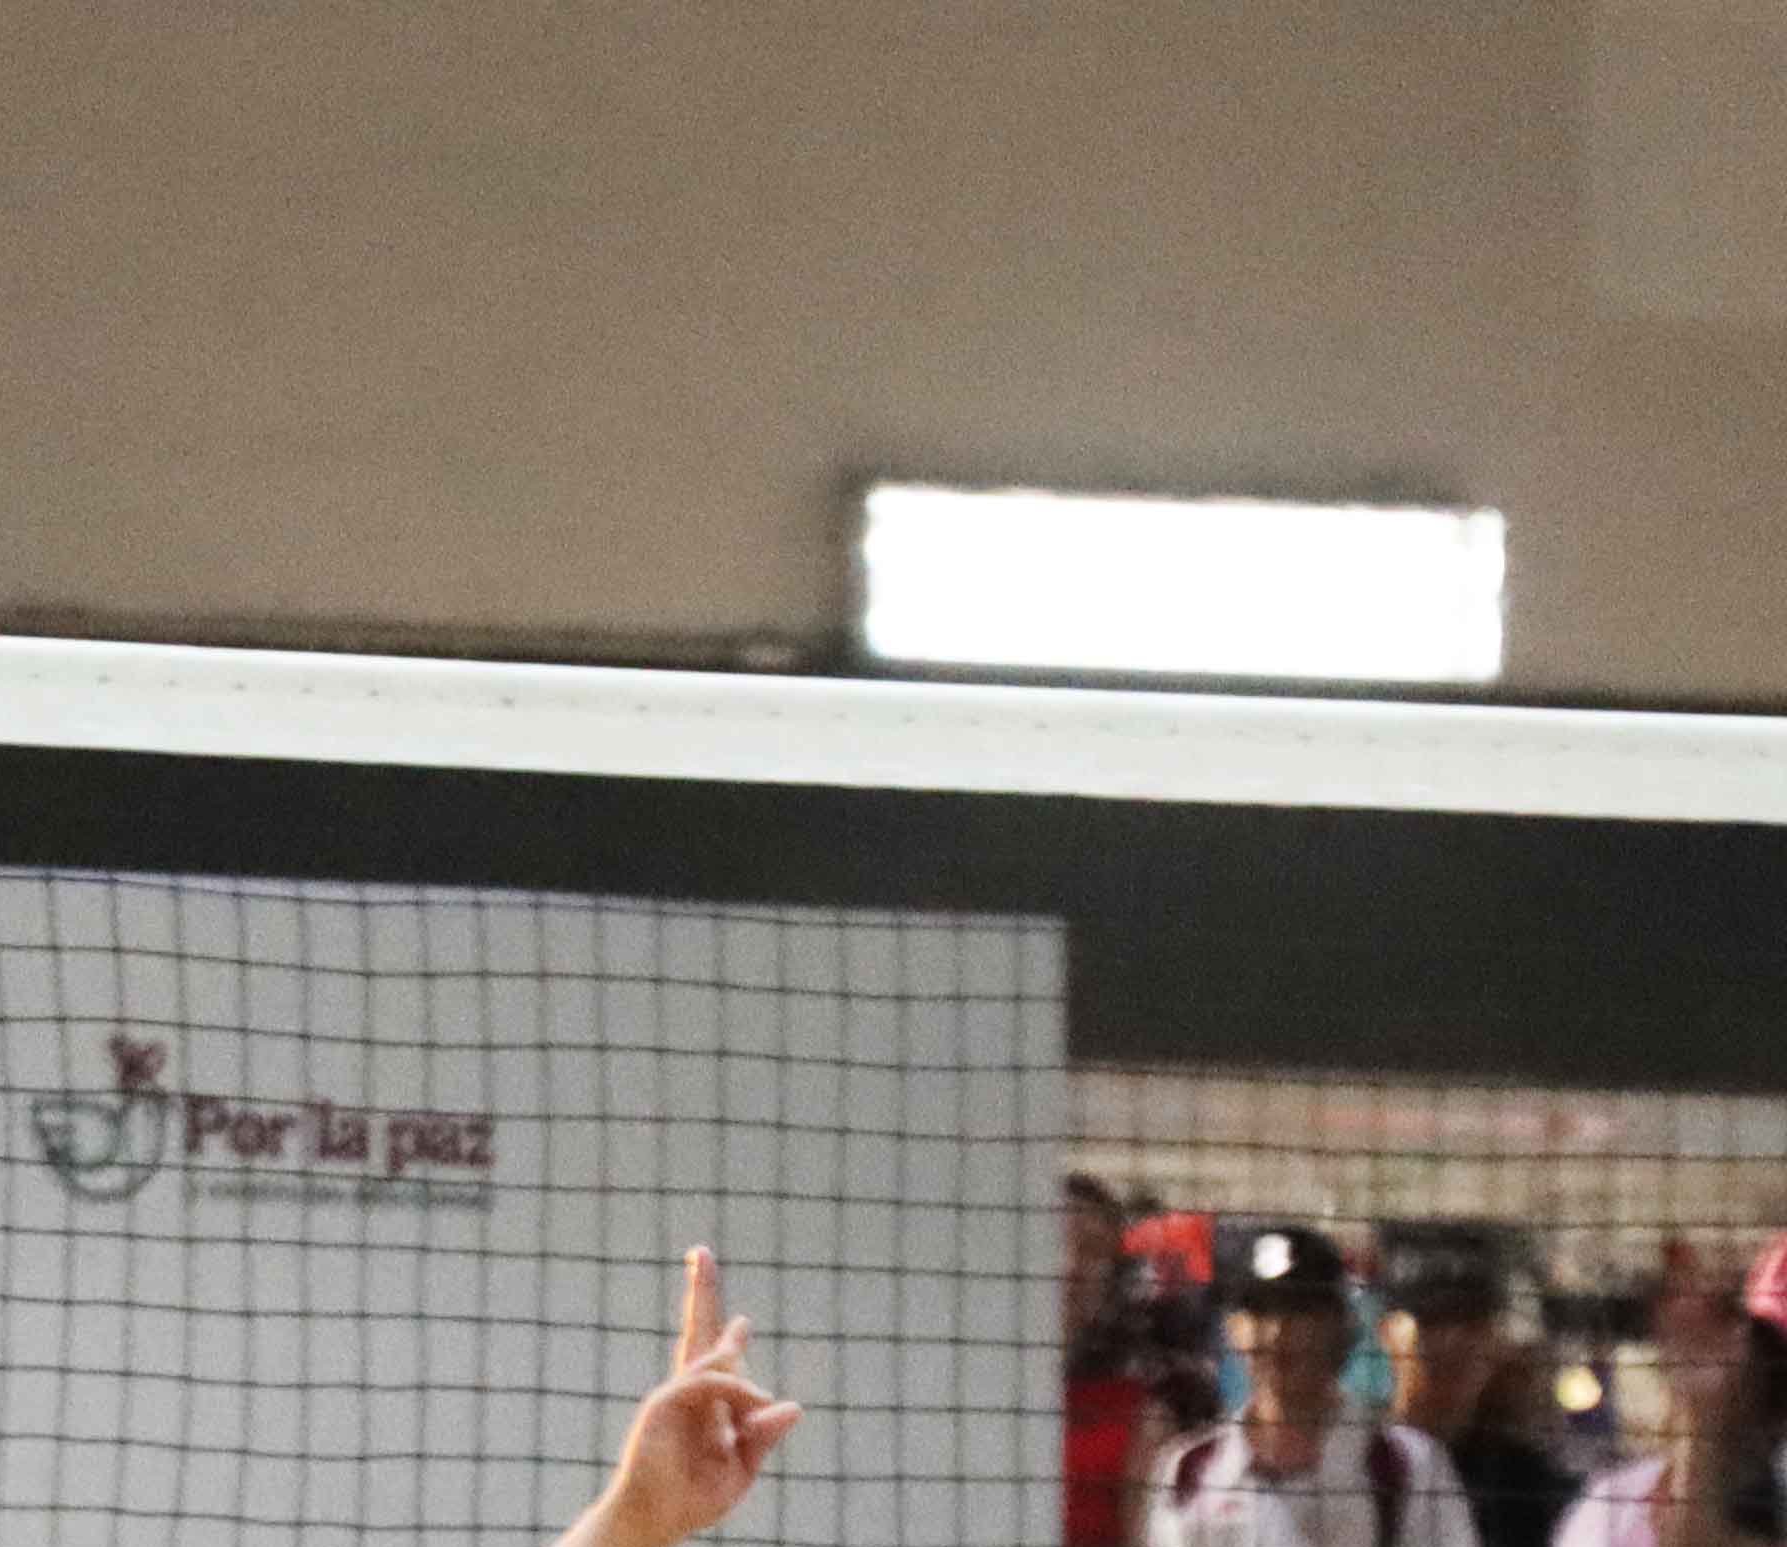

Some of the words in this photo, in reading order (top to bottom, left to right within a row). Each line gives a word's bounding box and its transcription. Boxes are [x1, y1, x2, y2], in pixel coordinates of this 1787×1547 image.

[184, 1096, 297, 1158] Por
[313, 1099, 370, 1160] la
[386, 1114, 494, 1180] paz
